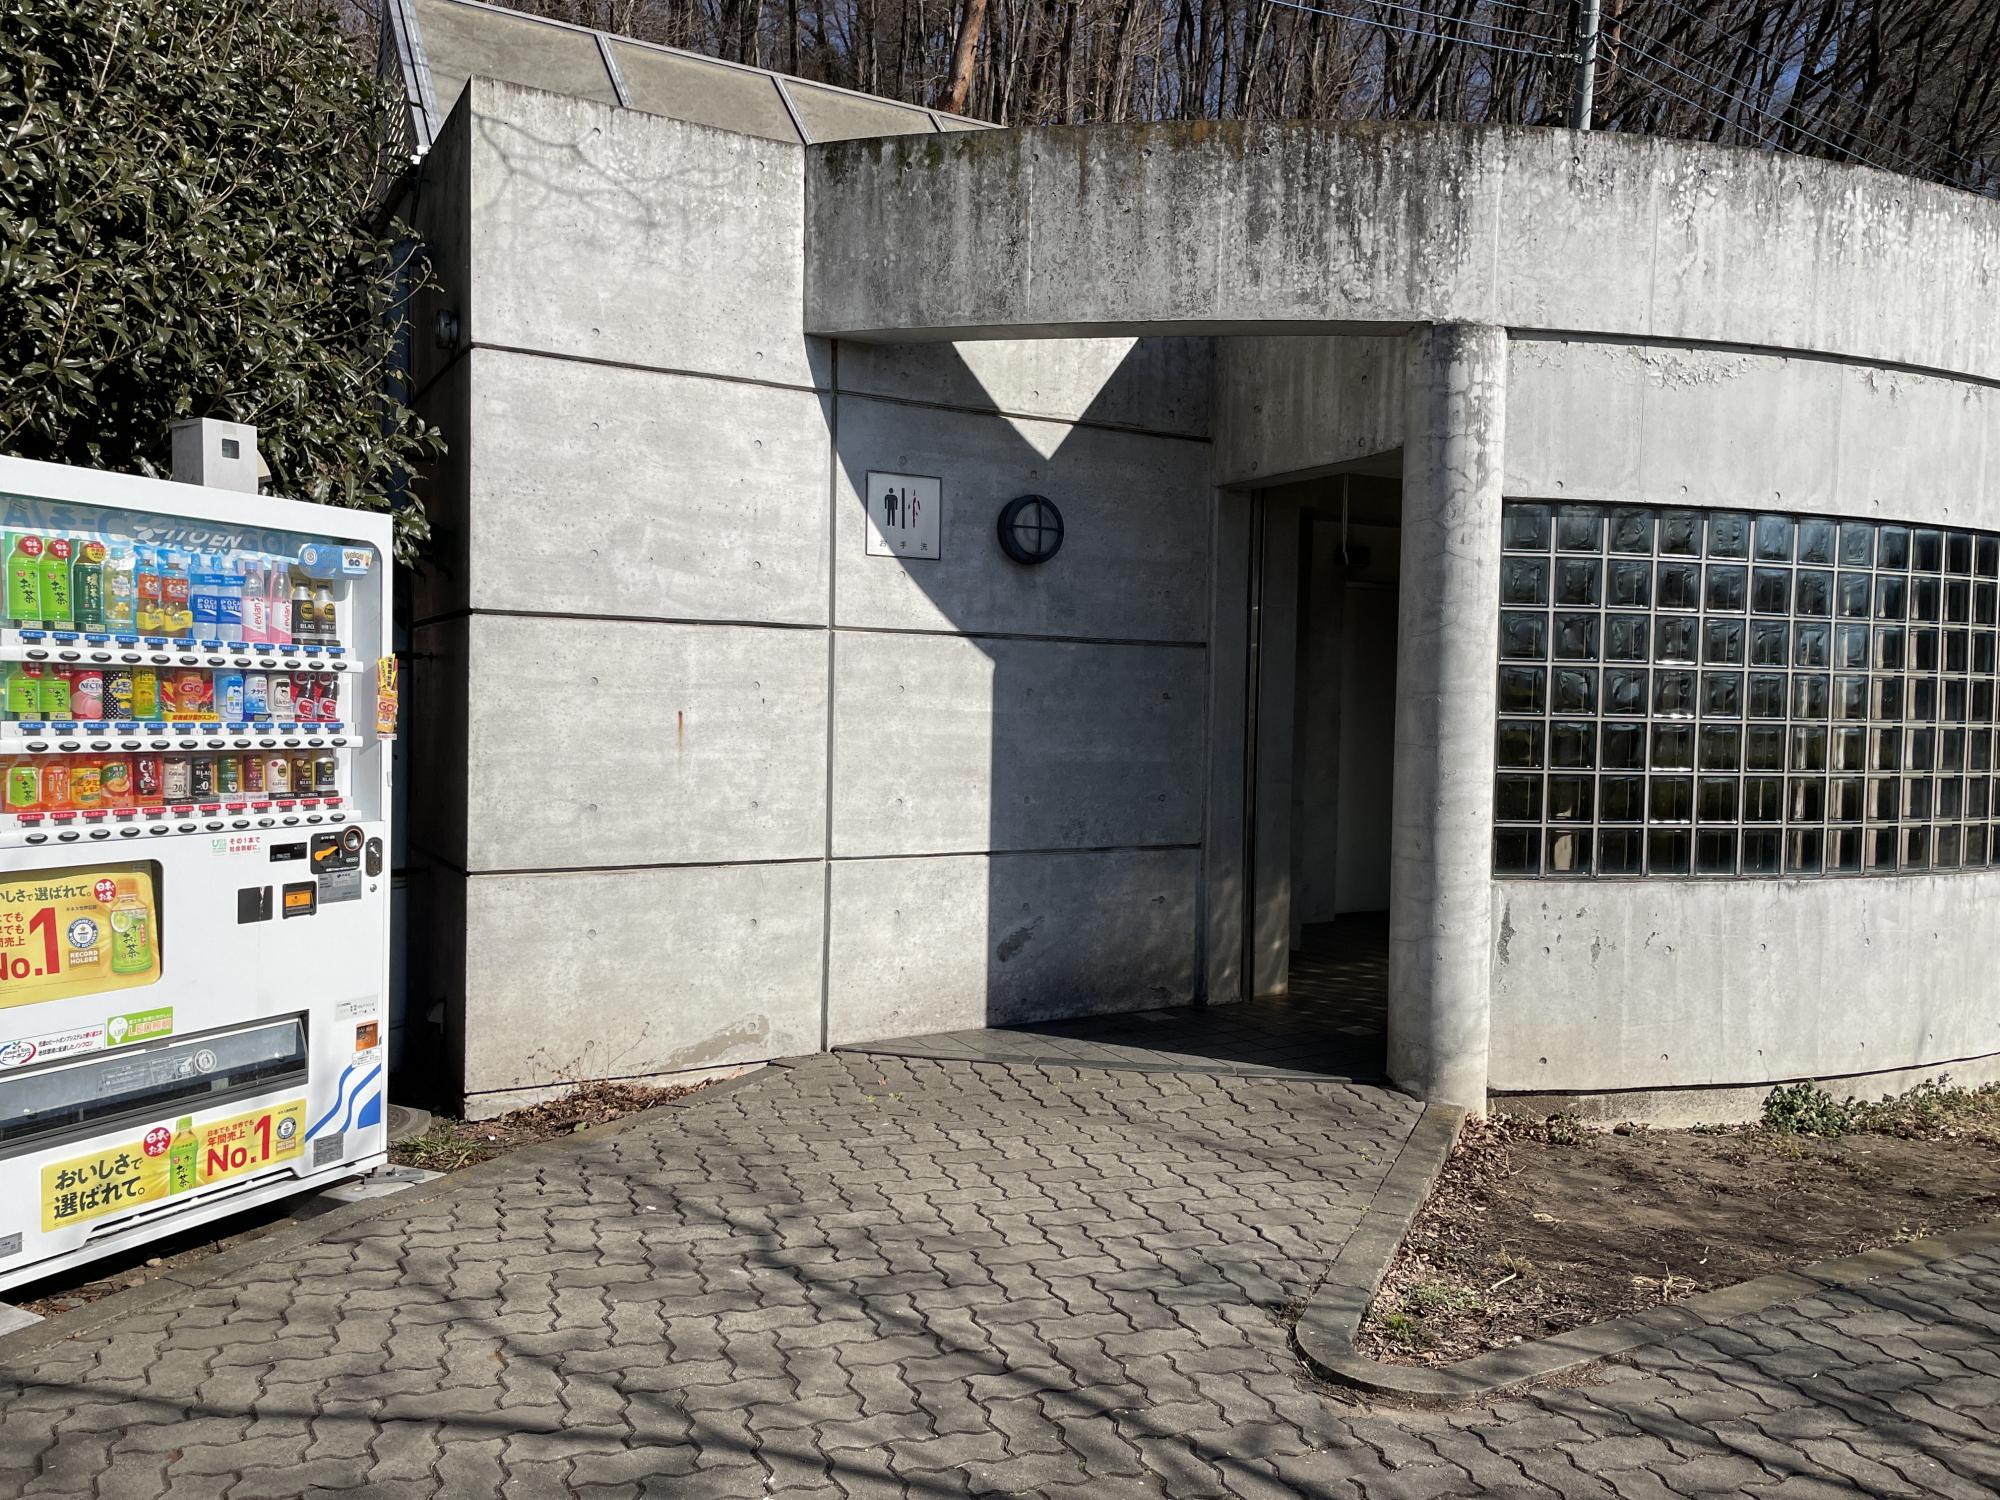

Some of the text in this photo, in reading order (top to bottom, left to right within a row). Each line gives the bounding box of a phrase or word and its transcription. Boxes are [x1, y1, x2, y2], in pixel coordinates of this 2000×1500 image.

[254, 602, 262, 626] evian
[70, 950, 98, 958] RECORD
[70, 956, 98, 965] HOLDER
[207, 1129, 246, 1147] 年間売上
[55, 1153, 144, 1190] おいしさで
[54, 1176, 146, 1220] 選ばれて。
